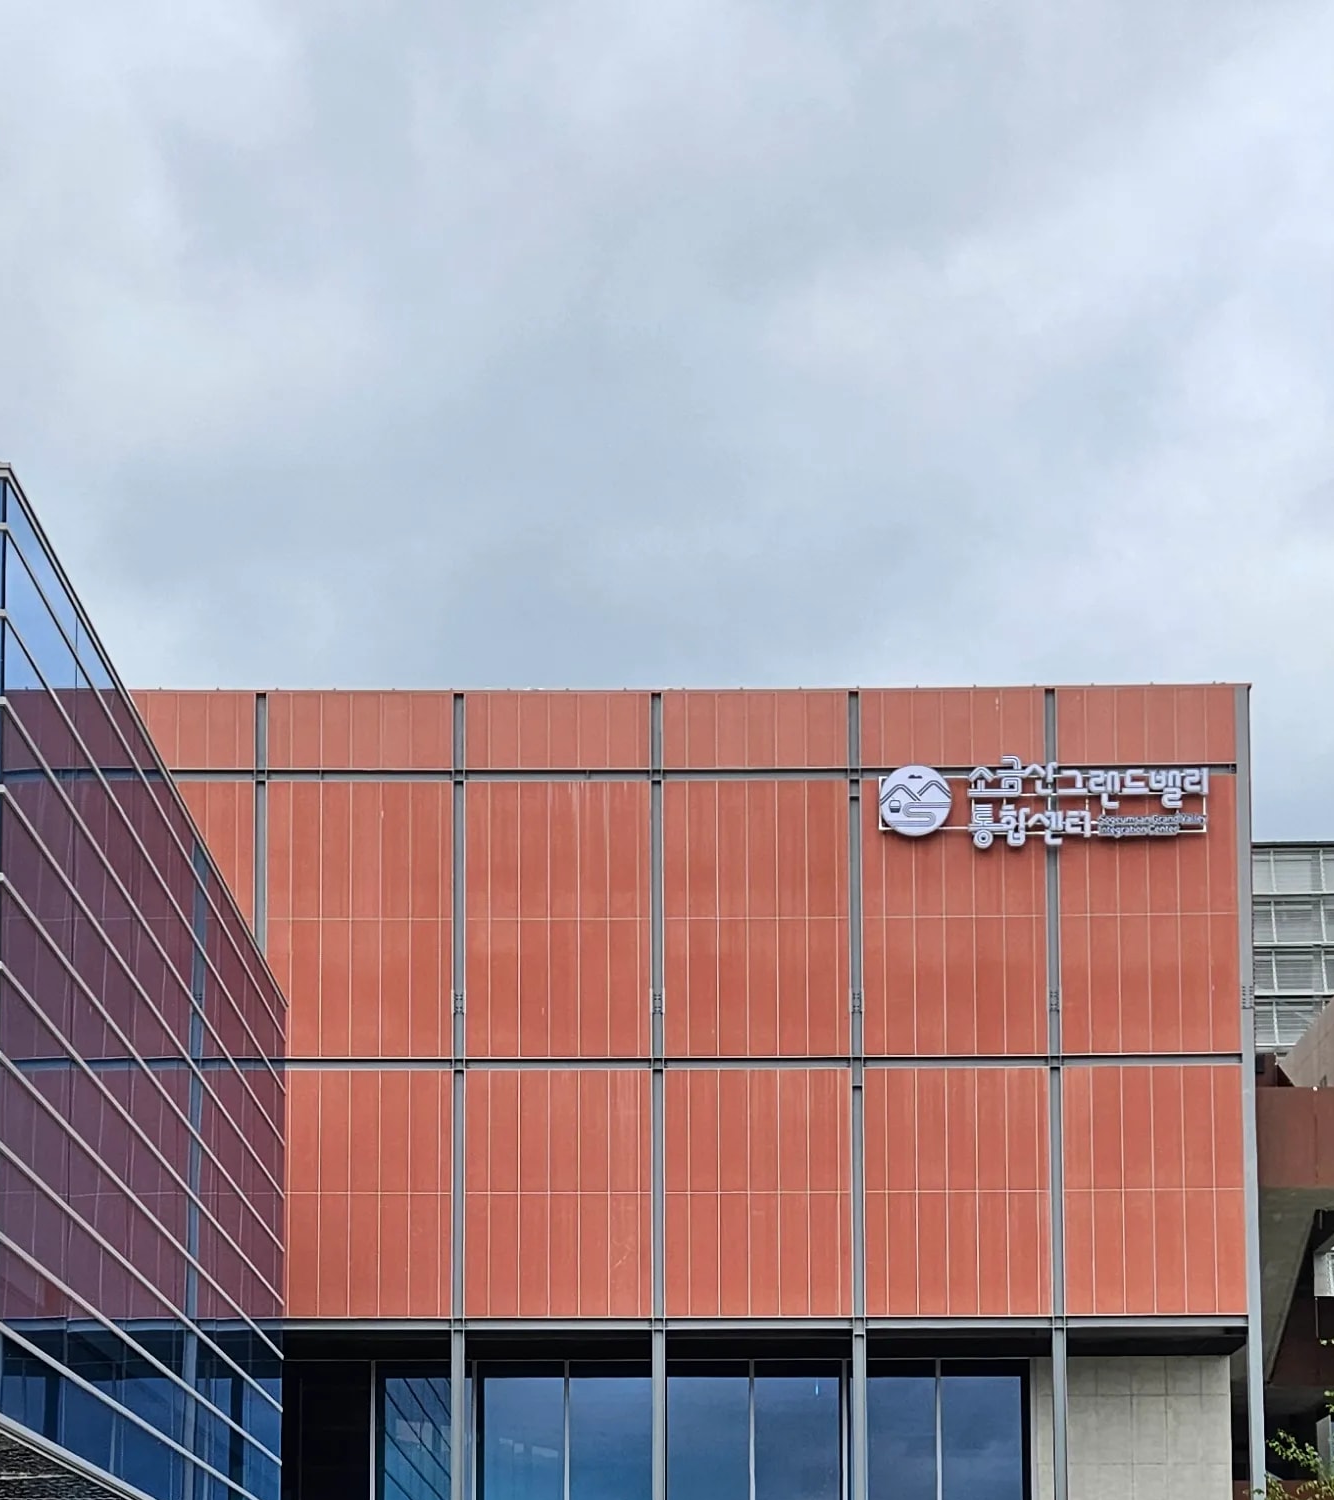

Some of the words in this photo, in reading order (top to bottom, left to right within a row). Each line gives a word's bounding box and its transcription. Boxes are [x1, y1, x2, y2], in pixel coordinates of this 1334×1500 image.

[968, 804, 1091, 849] 통합센터
[1152, 814, 1179, 825] Grand
[1098, 825, 1148, 838] Integration
[1148, 824, 1180, 836] Center
